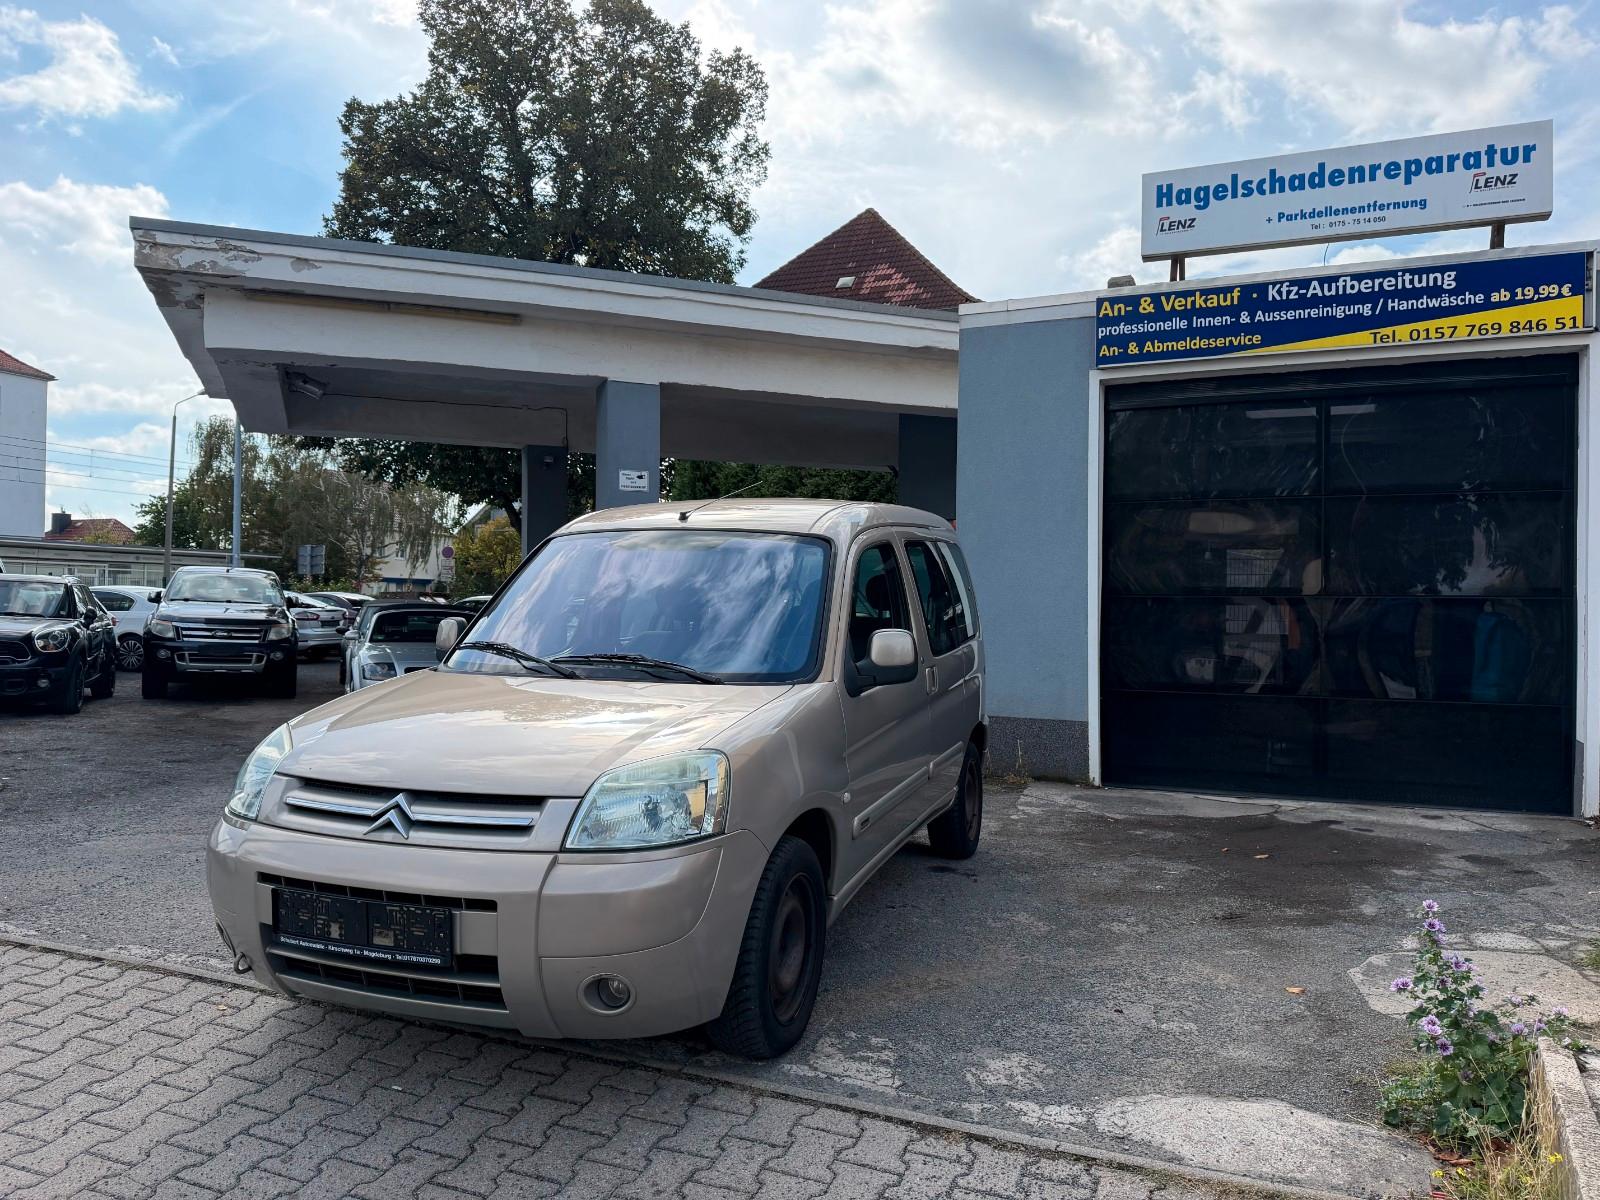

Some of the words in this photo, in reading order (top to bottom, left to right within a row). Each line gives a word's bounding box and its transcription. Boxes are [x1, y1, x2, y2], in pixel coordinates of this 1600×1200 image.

[1156, 144, 1537, 211] Hagelschadenreparatur
[1474, 173, 1519, 190] LENZ
[1278, 198, 1427, 223] Parkdellenentfernung
[1160, 217, 1197, 233] LENZ
[1329, 220, 1346, 228] 0175
[1352, 218, 1361, 226] 75
[1098, 301, 1133, 318] An-
[1139, 297, 1155, 314] &
[1161, 288, 1241, 312] Verkauf
[1268, 271, 1457, 302] Kfz-Aufbereitung
[1098, 317, 1188, 339] professionelle
[1192, 314, 1236, 328] Innen-
[1240, 311, 1251, 324] &
[1254, 303, 1373, 323] Aussenreinigung
[1387, 291, 1485, 312] Handwäsche
[1490, 288, 1511, 303] ab
[1369, 329, 1402, 345] Tel.
[1409, 325, 1458, 342] 0157
[1465, 322, 1503, 338] 769
[1509, 318, 1548, 334] 846
[1555, 315, 1580, 331] 51
[1099, 345, 1124, 357] An-
[1127, 342, 1140, 355] &
[1143, 333, 1262, 354] Abmeldeservice
[363, 949, 391, 960] Magdeburg
